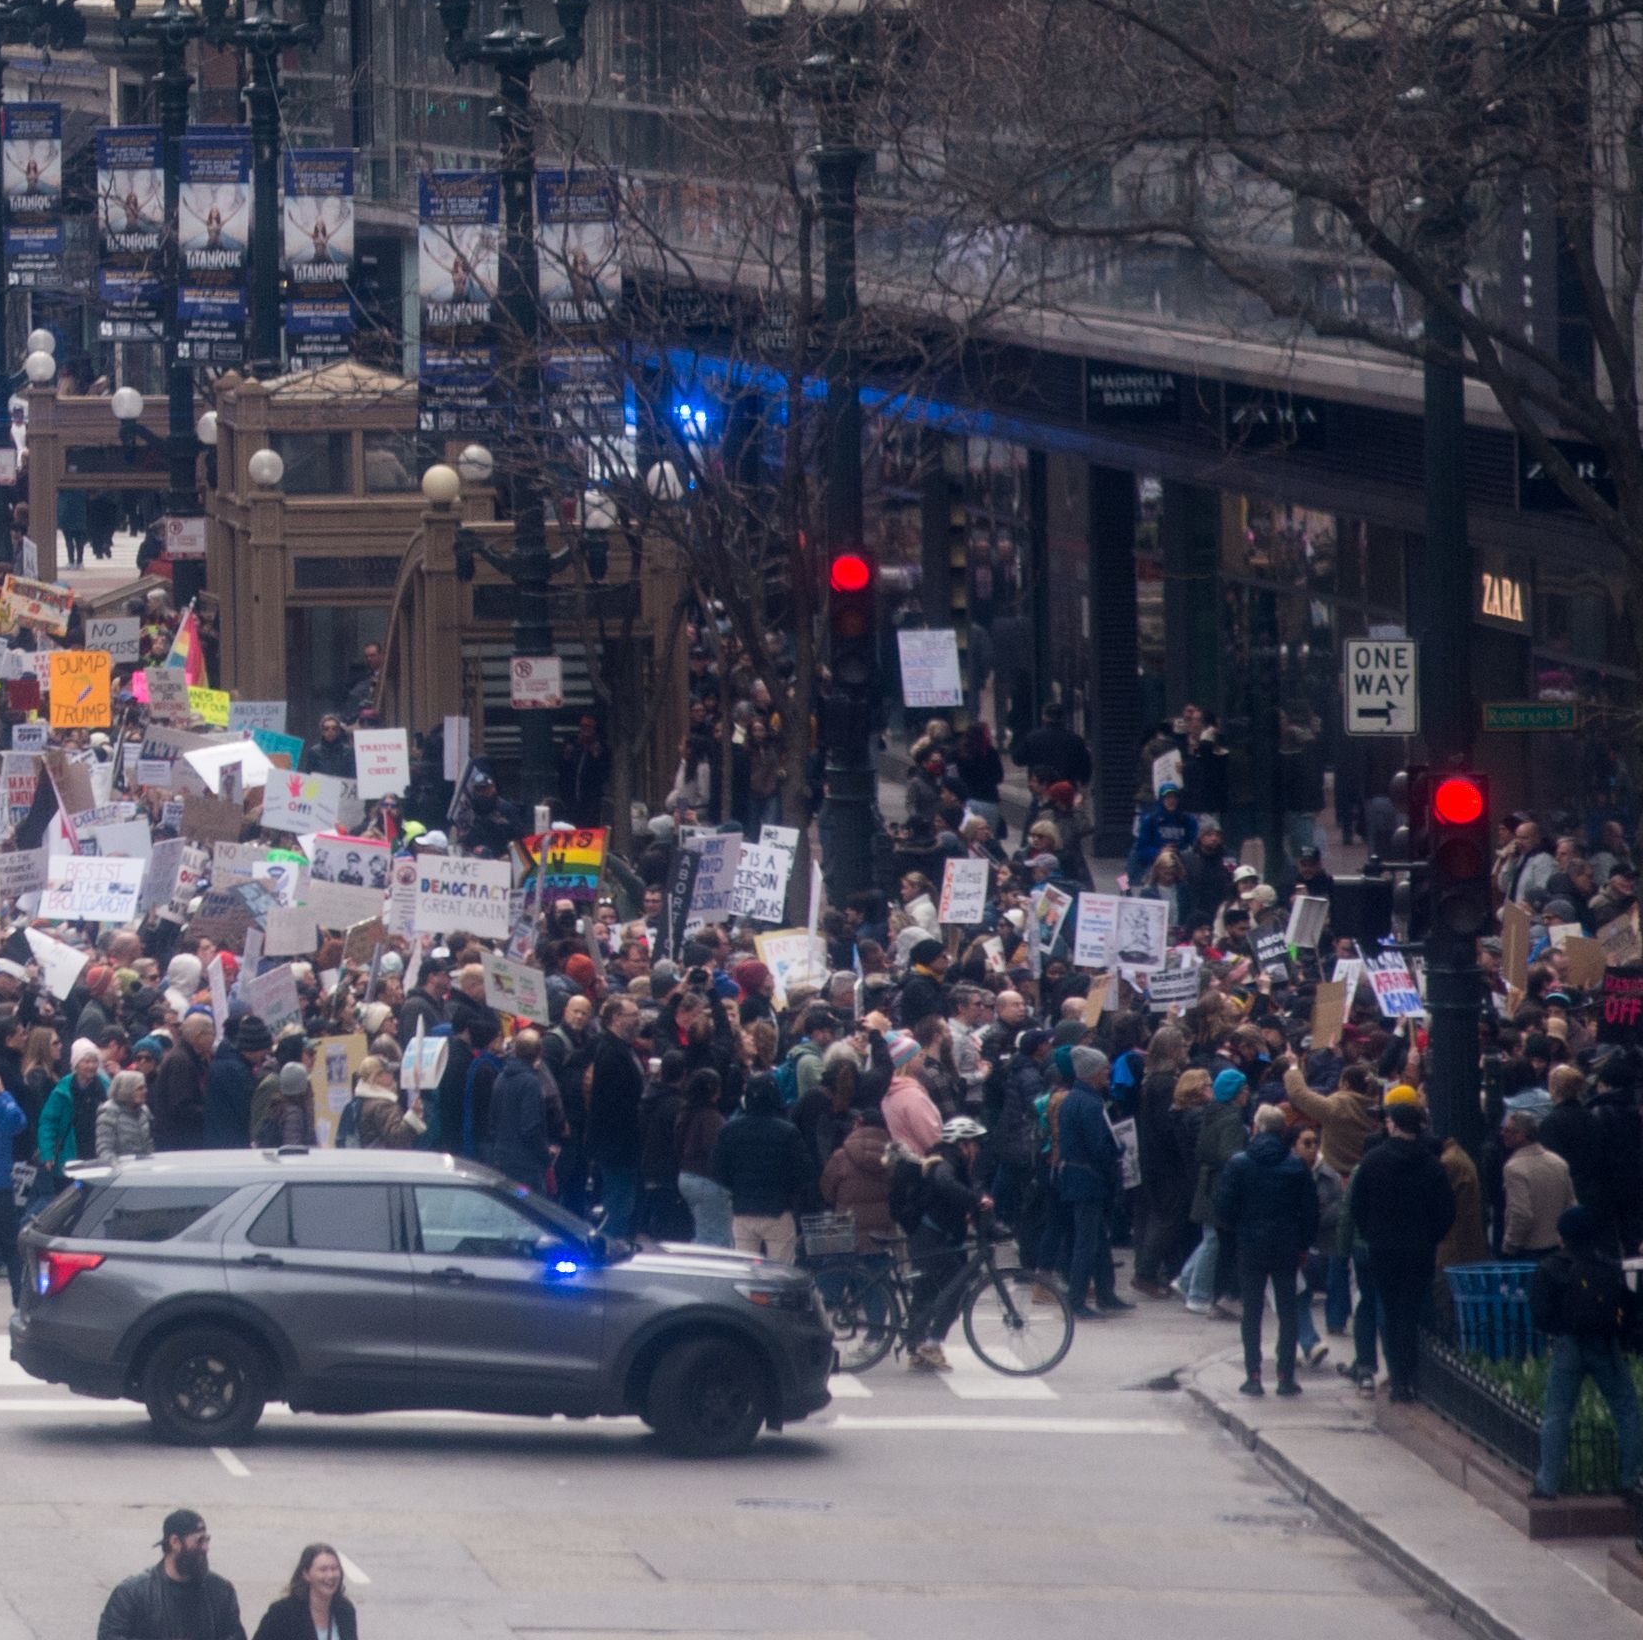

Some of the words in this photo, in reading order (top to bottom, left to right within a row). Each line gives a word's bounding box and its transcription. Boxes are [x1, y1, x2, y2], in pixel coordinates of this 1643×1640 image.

[1090, 374, 1175, 391] MAGNOLIA
[1102, 389, 1163, 406] BAKERY
[1482, 572, 1524, 622] ZARA
[91, 623, 117, 638] NO
[55, 654, 107, 675] DUMP
[1355, 647, 1409, 670] ONE
[1354, 674, 1410, 696] WAY
[52, 705, 109, 725] TRUMP
[359, 742, 403, 754] TRAITOR
[367, 765, 398, 777] CHIEF
[749, 850, 762, 867] IS
[767, 855, 776, 870] A
[76, 882, 104, 894] THE
[421, 879, 511, 901] DEMOCRACY
[47, 894, 136, 914] BROLIGARCHY
[422, 898, 465, 913] GREAT
[466, 902, 507, 920] AGAIN
[1604, 996, 1642, 1024] OFF
